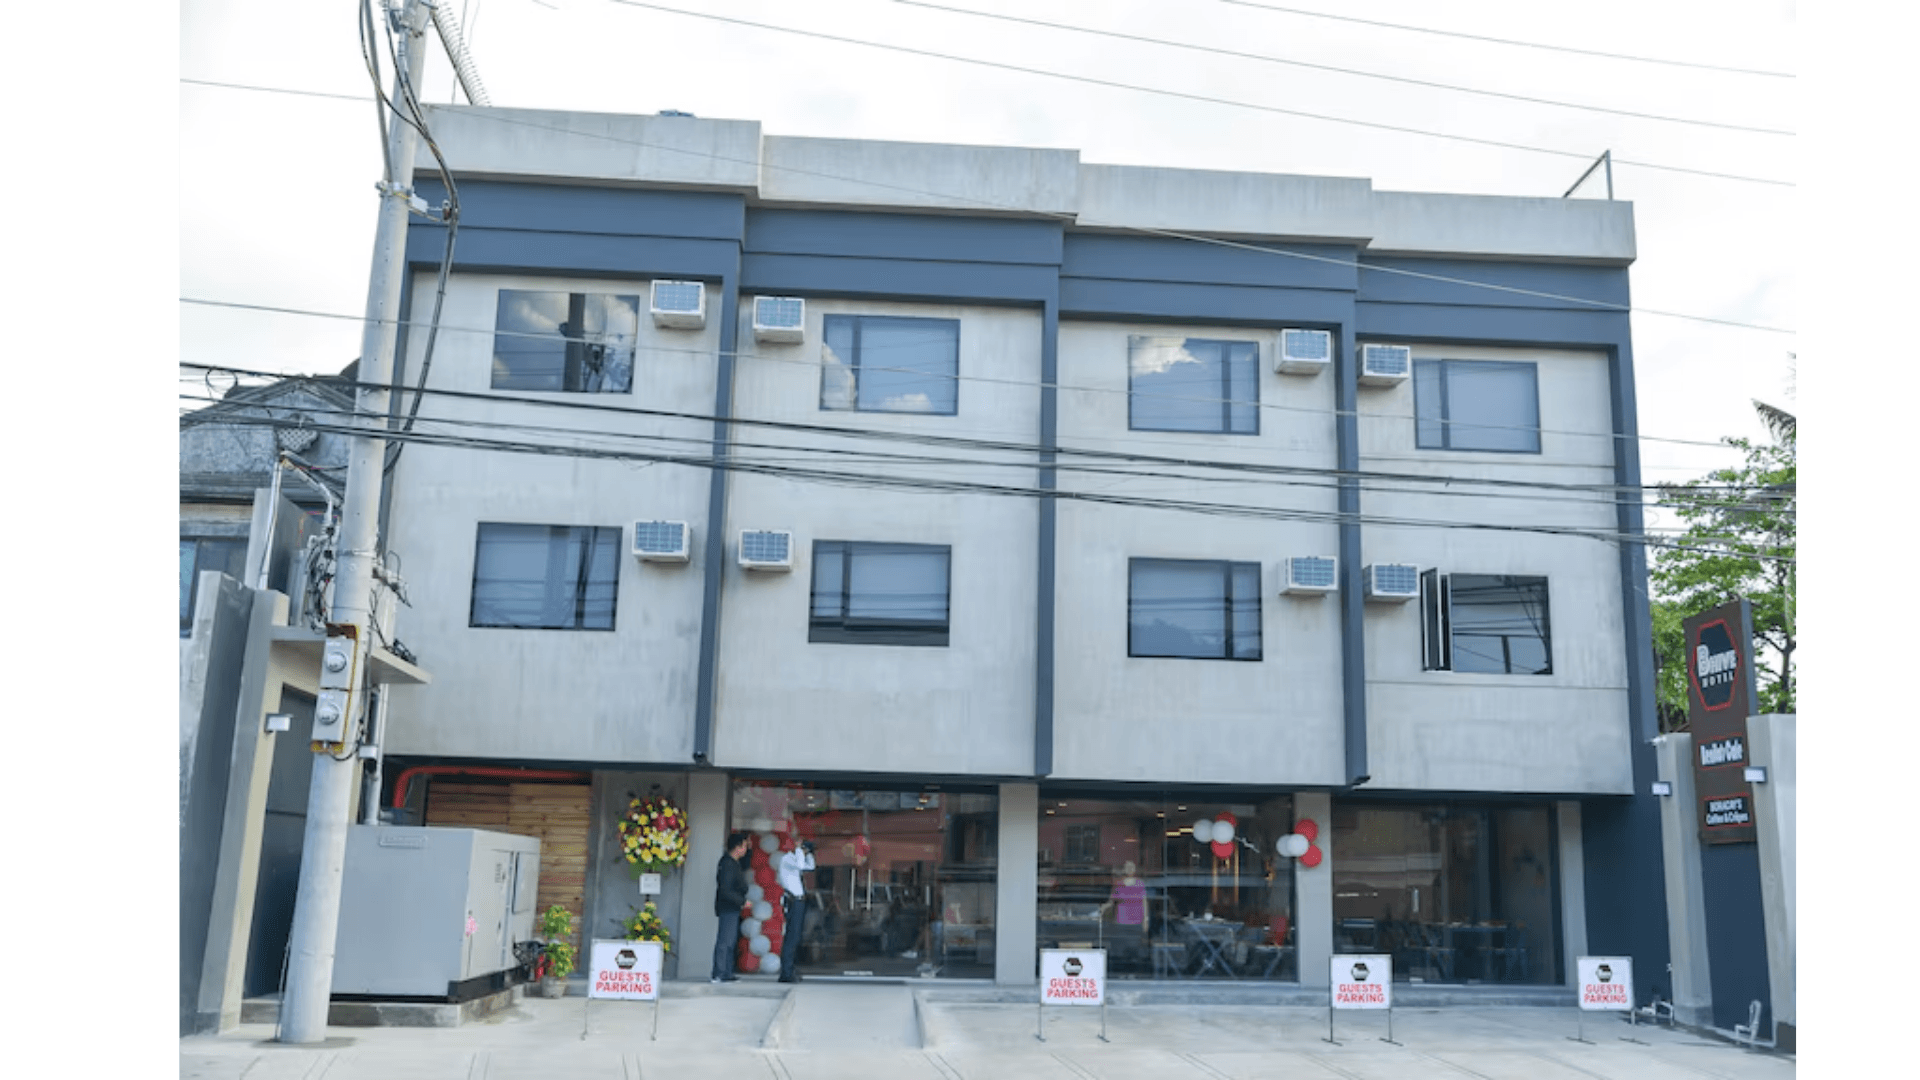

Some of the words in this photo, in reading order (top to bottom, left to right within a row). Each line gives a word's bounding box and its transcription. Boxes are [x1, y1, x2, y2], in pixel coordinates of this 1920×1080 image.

[599, 969, 650, 982] GUESTS
[595, 981, 652, 994] PARKING
[1049, 978, 1097, 989] GUESTS
[1339, 983, 1383, 993] GUESTS
[1585, 983, 1626, 994] GUESTS
[1046, 988, 1099, 999] PARKING
[1336, 993, 1385, 1004] PARKING
[1584, 993, 1627, 1004] PARKING
